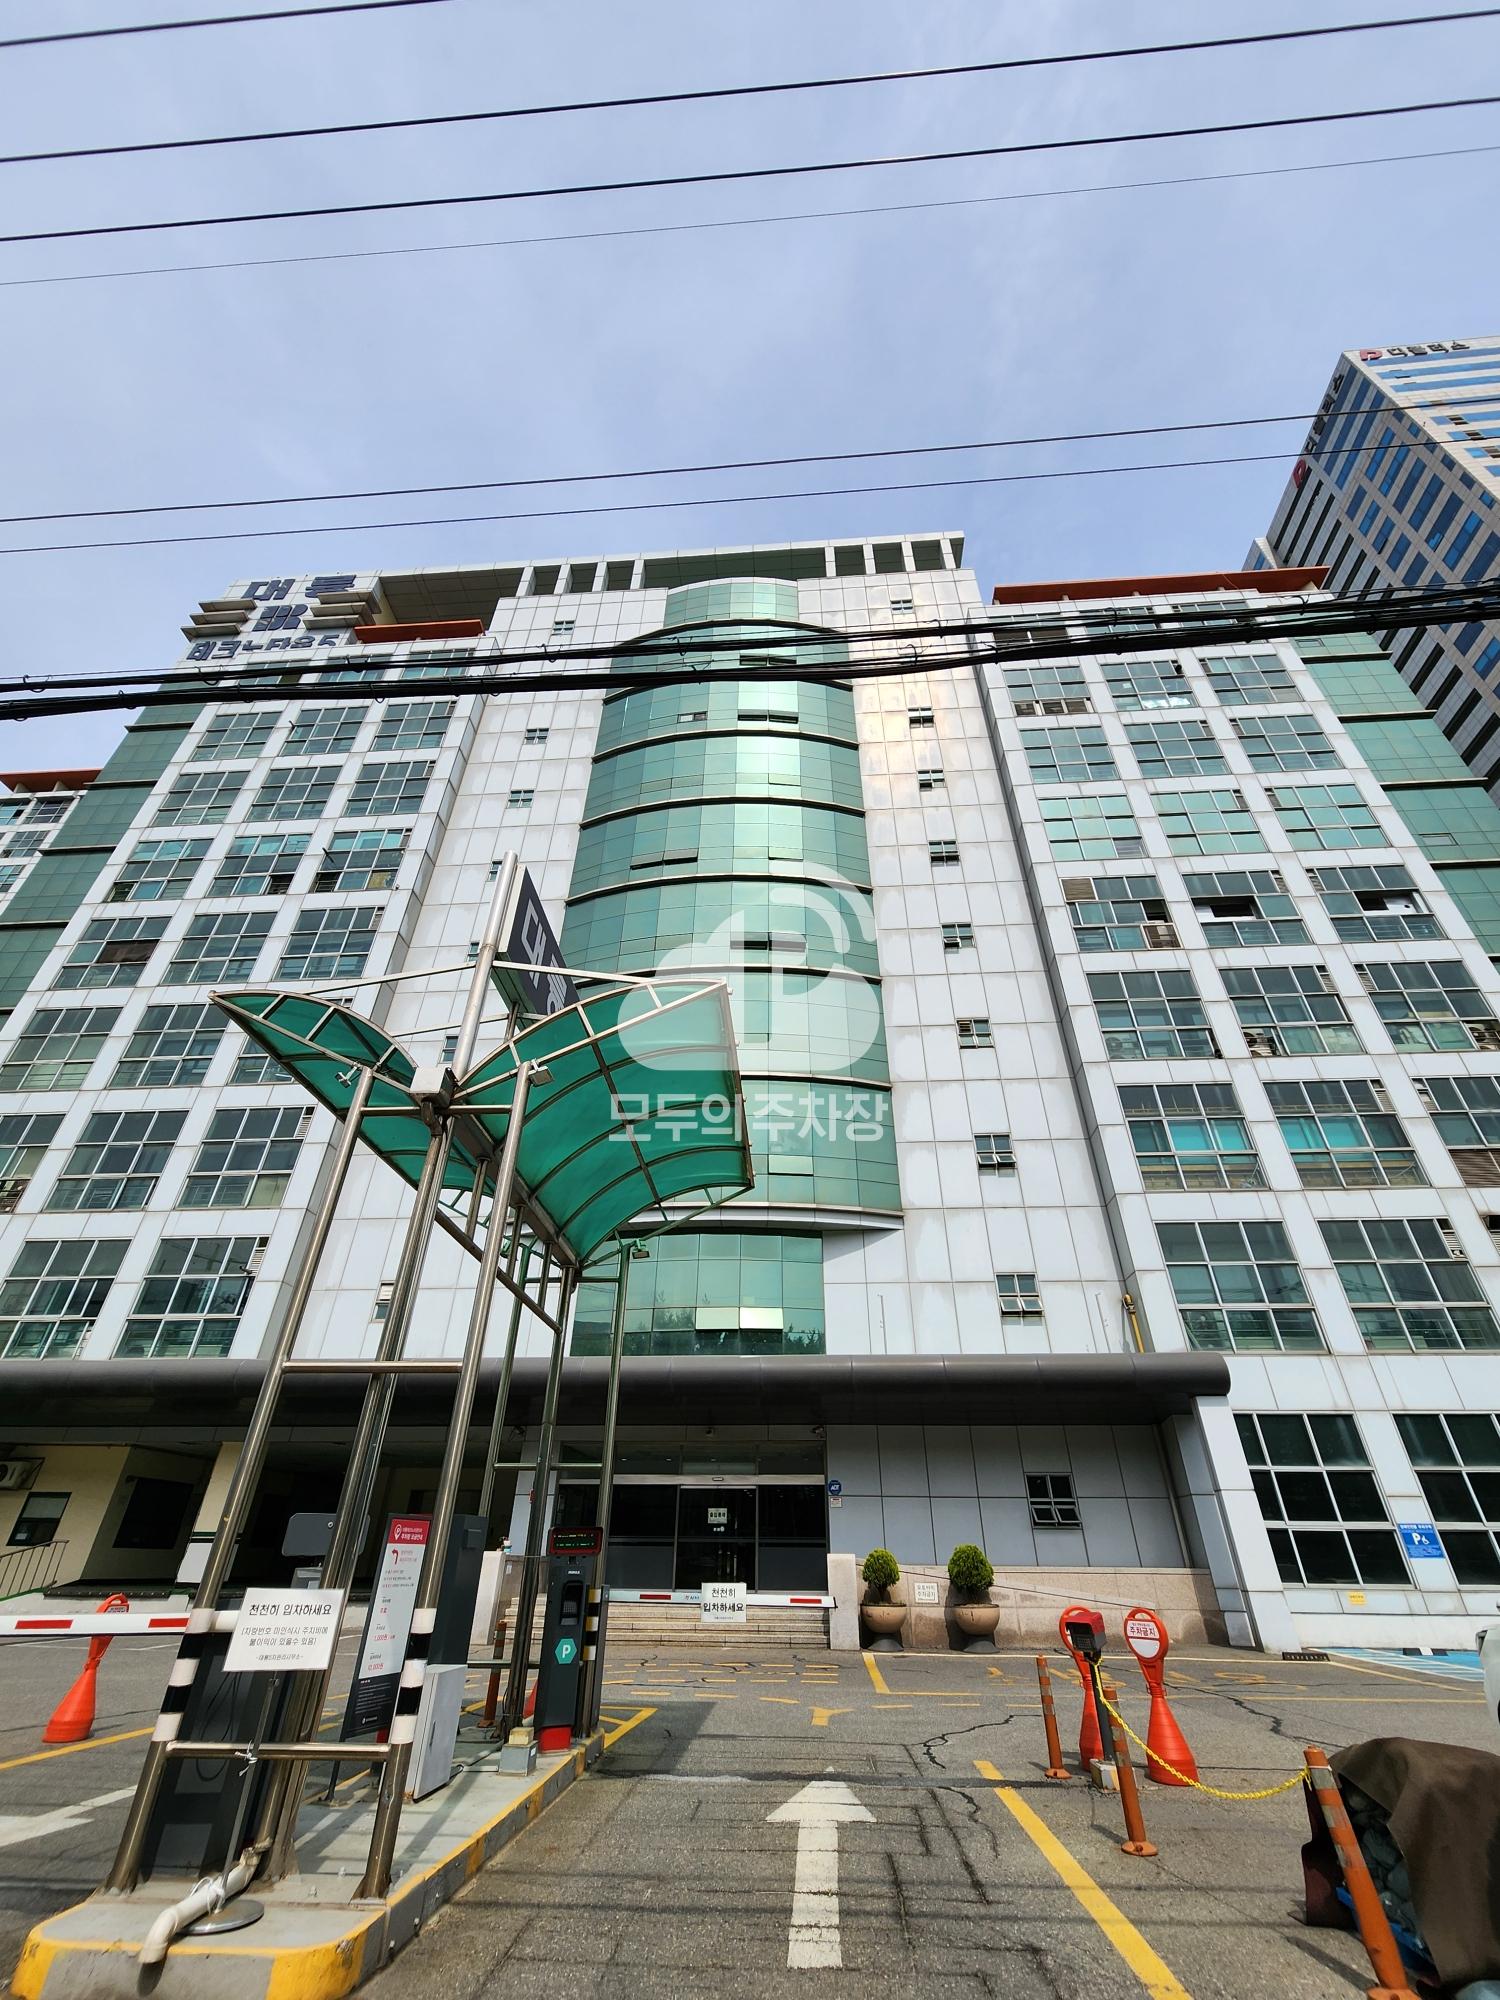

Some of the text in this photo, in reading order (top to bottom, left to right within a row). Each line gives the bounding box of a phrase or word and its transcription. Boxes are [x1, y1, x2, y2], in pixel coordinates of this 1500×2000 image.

[1412, 1532, 1421, 1545] P
[711, 1587, 736, 1599] 천천히
[248, 1603, 333, 1616] 천천히 입차하세요
[703, 1602, 745, 1613] 입차하세요
[272, 1626, 301, 1636] 미인식시
[1129, 1626, 1156, 1637] 주차금지
[249, 1637, 277, 1647] 불이익이
[561, 1644, 572, 1658] P
